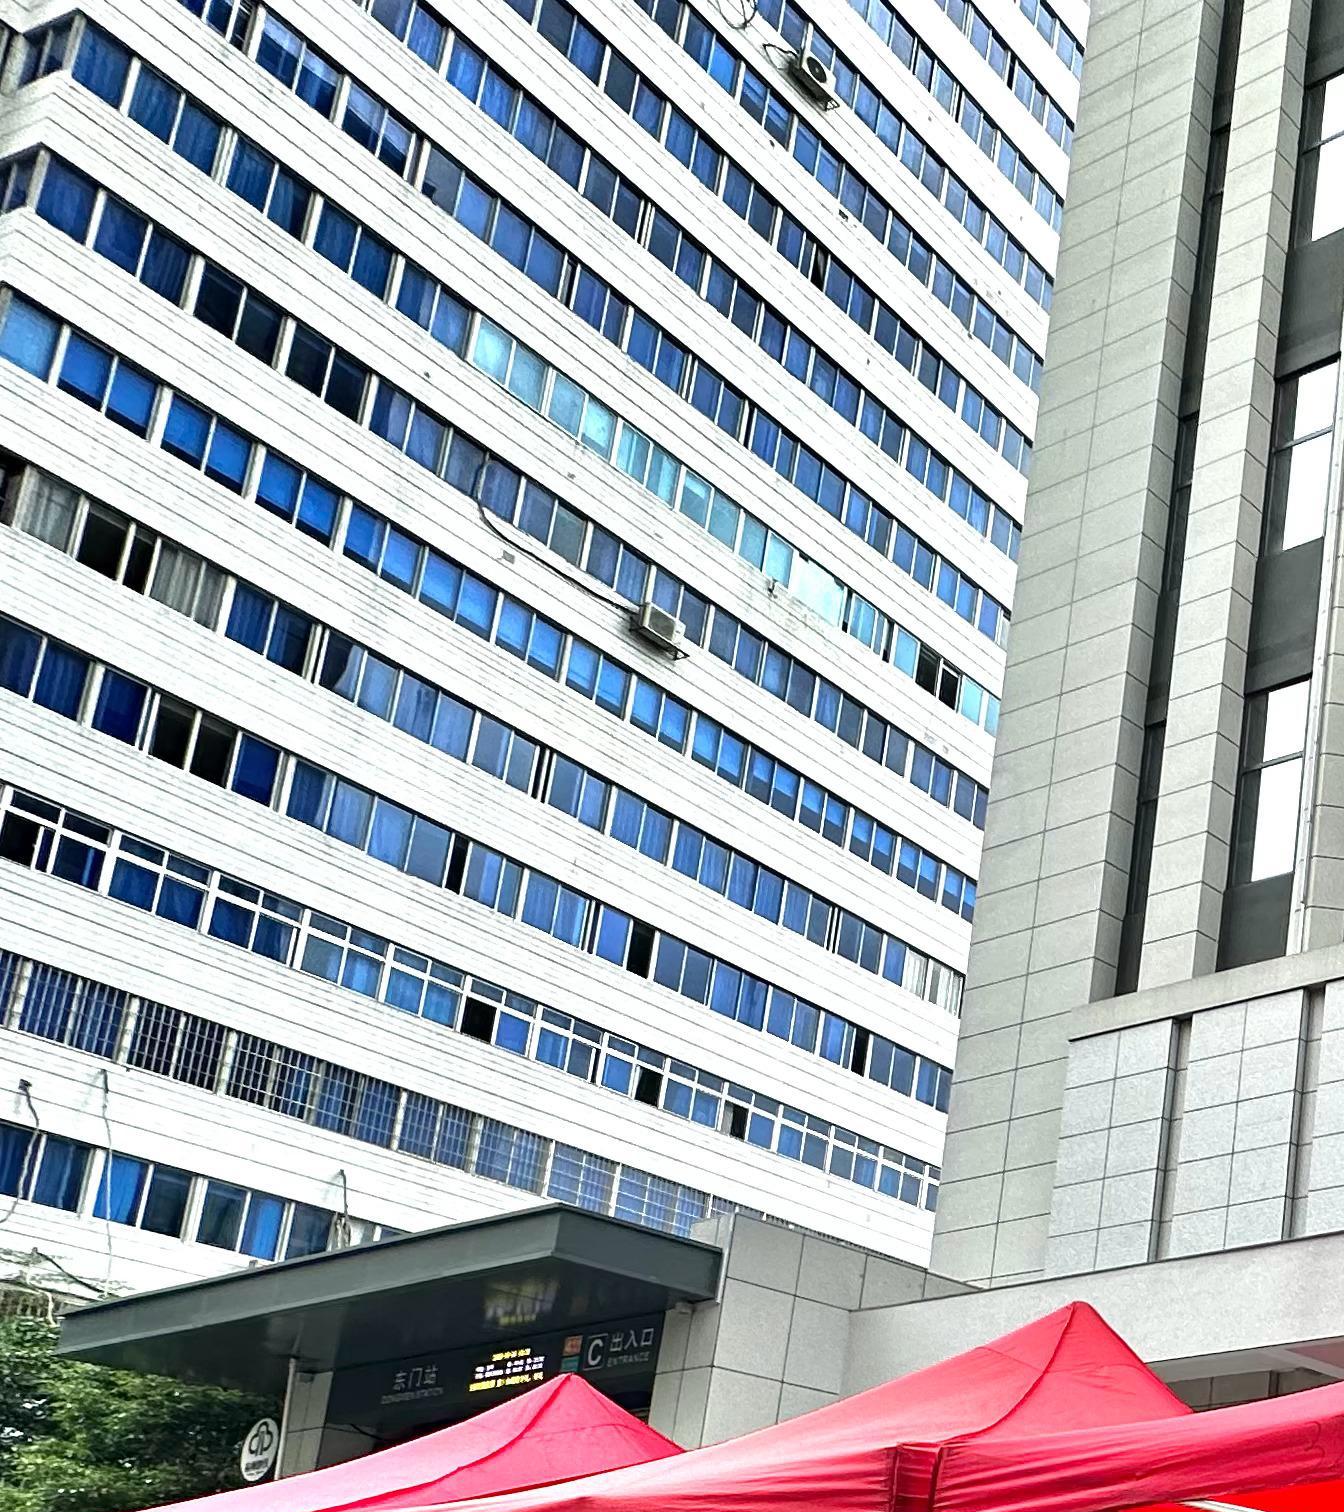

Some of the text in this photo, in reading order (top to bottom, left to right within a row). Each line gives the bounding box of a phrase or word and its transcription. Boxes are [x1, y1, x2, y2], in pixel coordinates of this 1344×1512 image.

[587, 1327, 655, 1366] C 出入口
[606, 1351, 650, 1368] ENTRANCE
